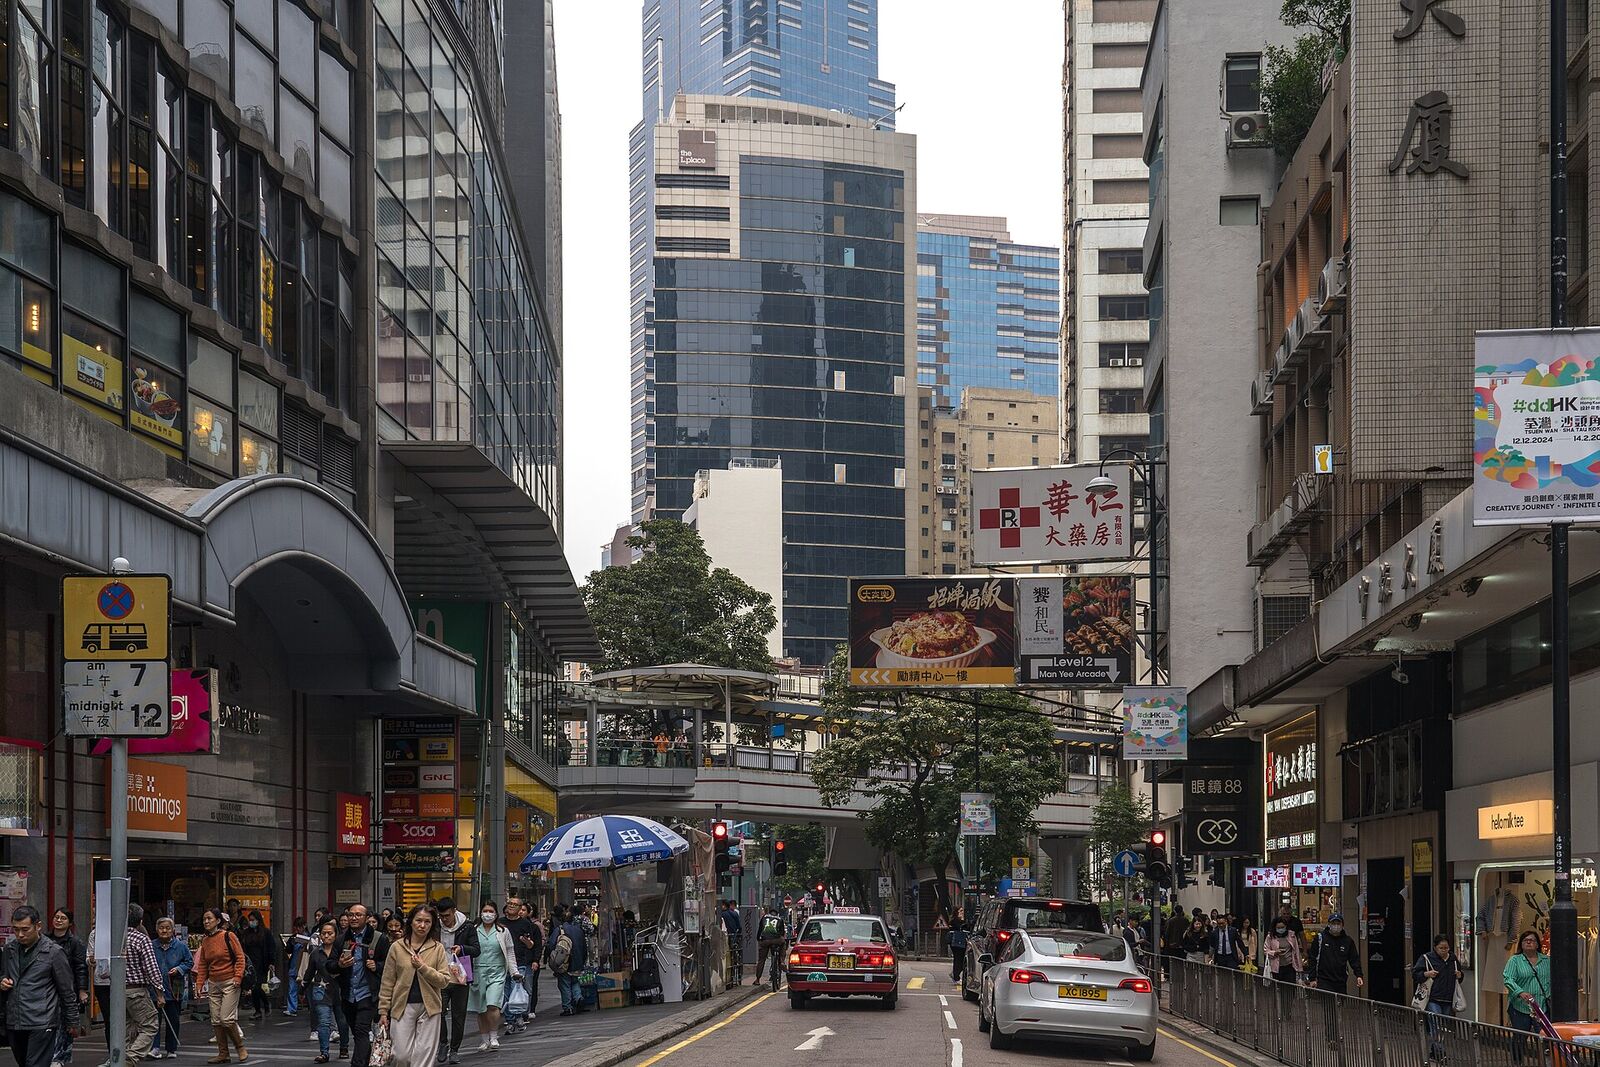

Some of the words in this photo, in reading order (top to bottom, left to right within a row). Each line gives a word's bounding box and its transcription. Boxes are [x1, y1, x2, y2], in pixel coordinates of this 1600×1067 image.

[1513, 397, 1578, 413] #ddHK
[1045, 522, 1110, 546] 大藥房
[927, 579, 1014, 611] 招牌焗飯
[1054, 657, 1084, 667] Level
[1086, 657, 1093, 667] 2
[82, 675, 110, 686] 上午
[87, 662, 105, 670] am
[130, 663, 147, 686] 7
[1039, 670, 1056, 678] Man
[1058, 670, 1073, 678] Yee
[1075, 670, 1106, 678] Arcade
[69, 701, 124, 712] midnight
[130, 704, 162, 728] 12
[82, 714, 110, 728] 午夜
[127, 793, 181, 821] mannings
[345, 802, 363, 829] 惠康
[342, 832, 366, 846] wellcome
[561, 860, 580, 869] 2116
[1314, 865, 1337, 877] 華仁
